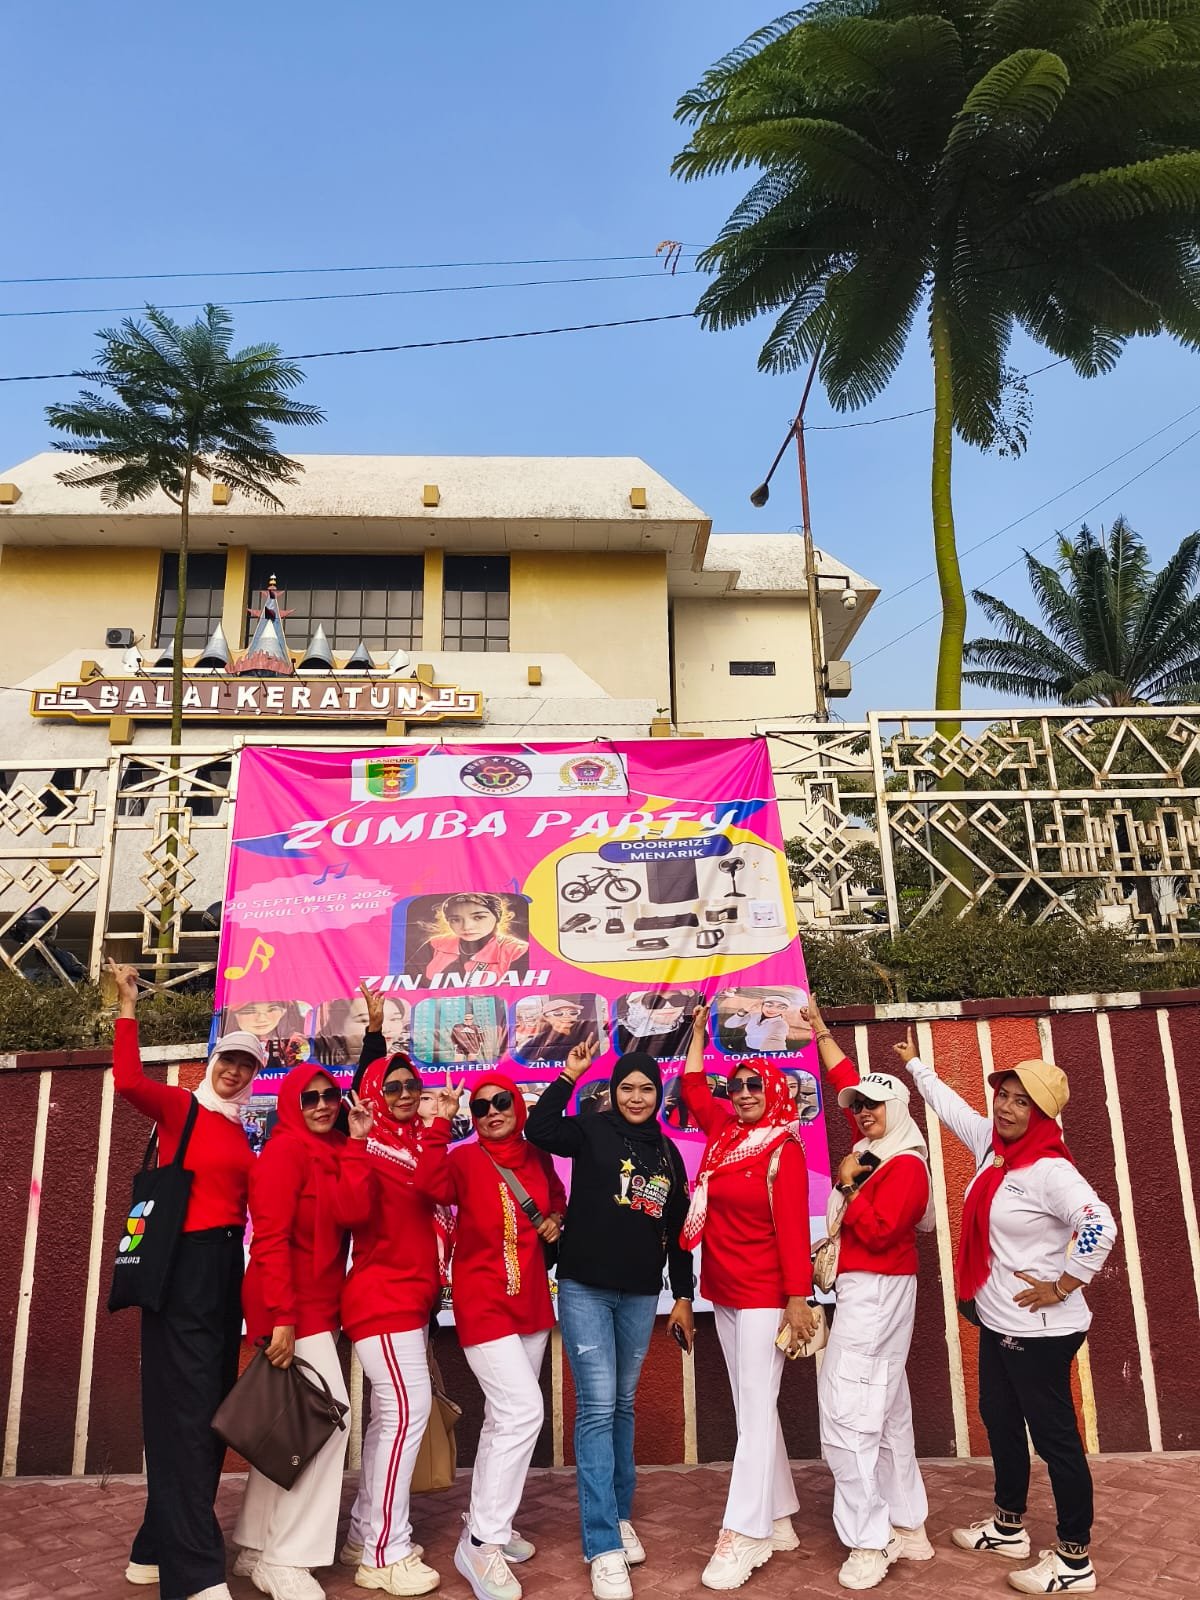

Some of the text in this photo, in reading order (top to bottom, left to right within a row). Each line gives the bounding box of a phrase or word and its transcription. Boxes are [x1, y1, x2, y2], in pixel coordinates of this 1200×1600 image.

[100, 686, 419, 708] BALAI KERATUN
[282, 809, 739, 850] ZUMBA PARTY
[621, 836, 712, 861] DOORPRIZE MENARIK
[253, 893, 347, 909] SEPTEMBER
[243, 909, 297, 921] PUKUL
[351, 901, 380, 910] WIB
[354, 969, 551, 992] ZIN INDAH
[528, 1060, 566, 1069] ZIN RI
[723, 1051, 804, 1062] COACH TARA
[253, 1072, 290, 1081] ANIT
[332, 1069, 354, 1078] ZIN
[420, 1063, 499, 1074] COACH FEBY
